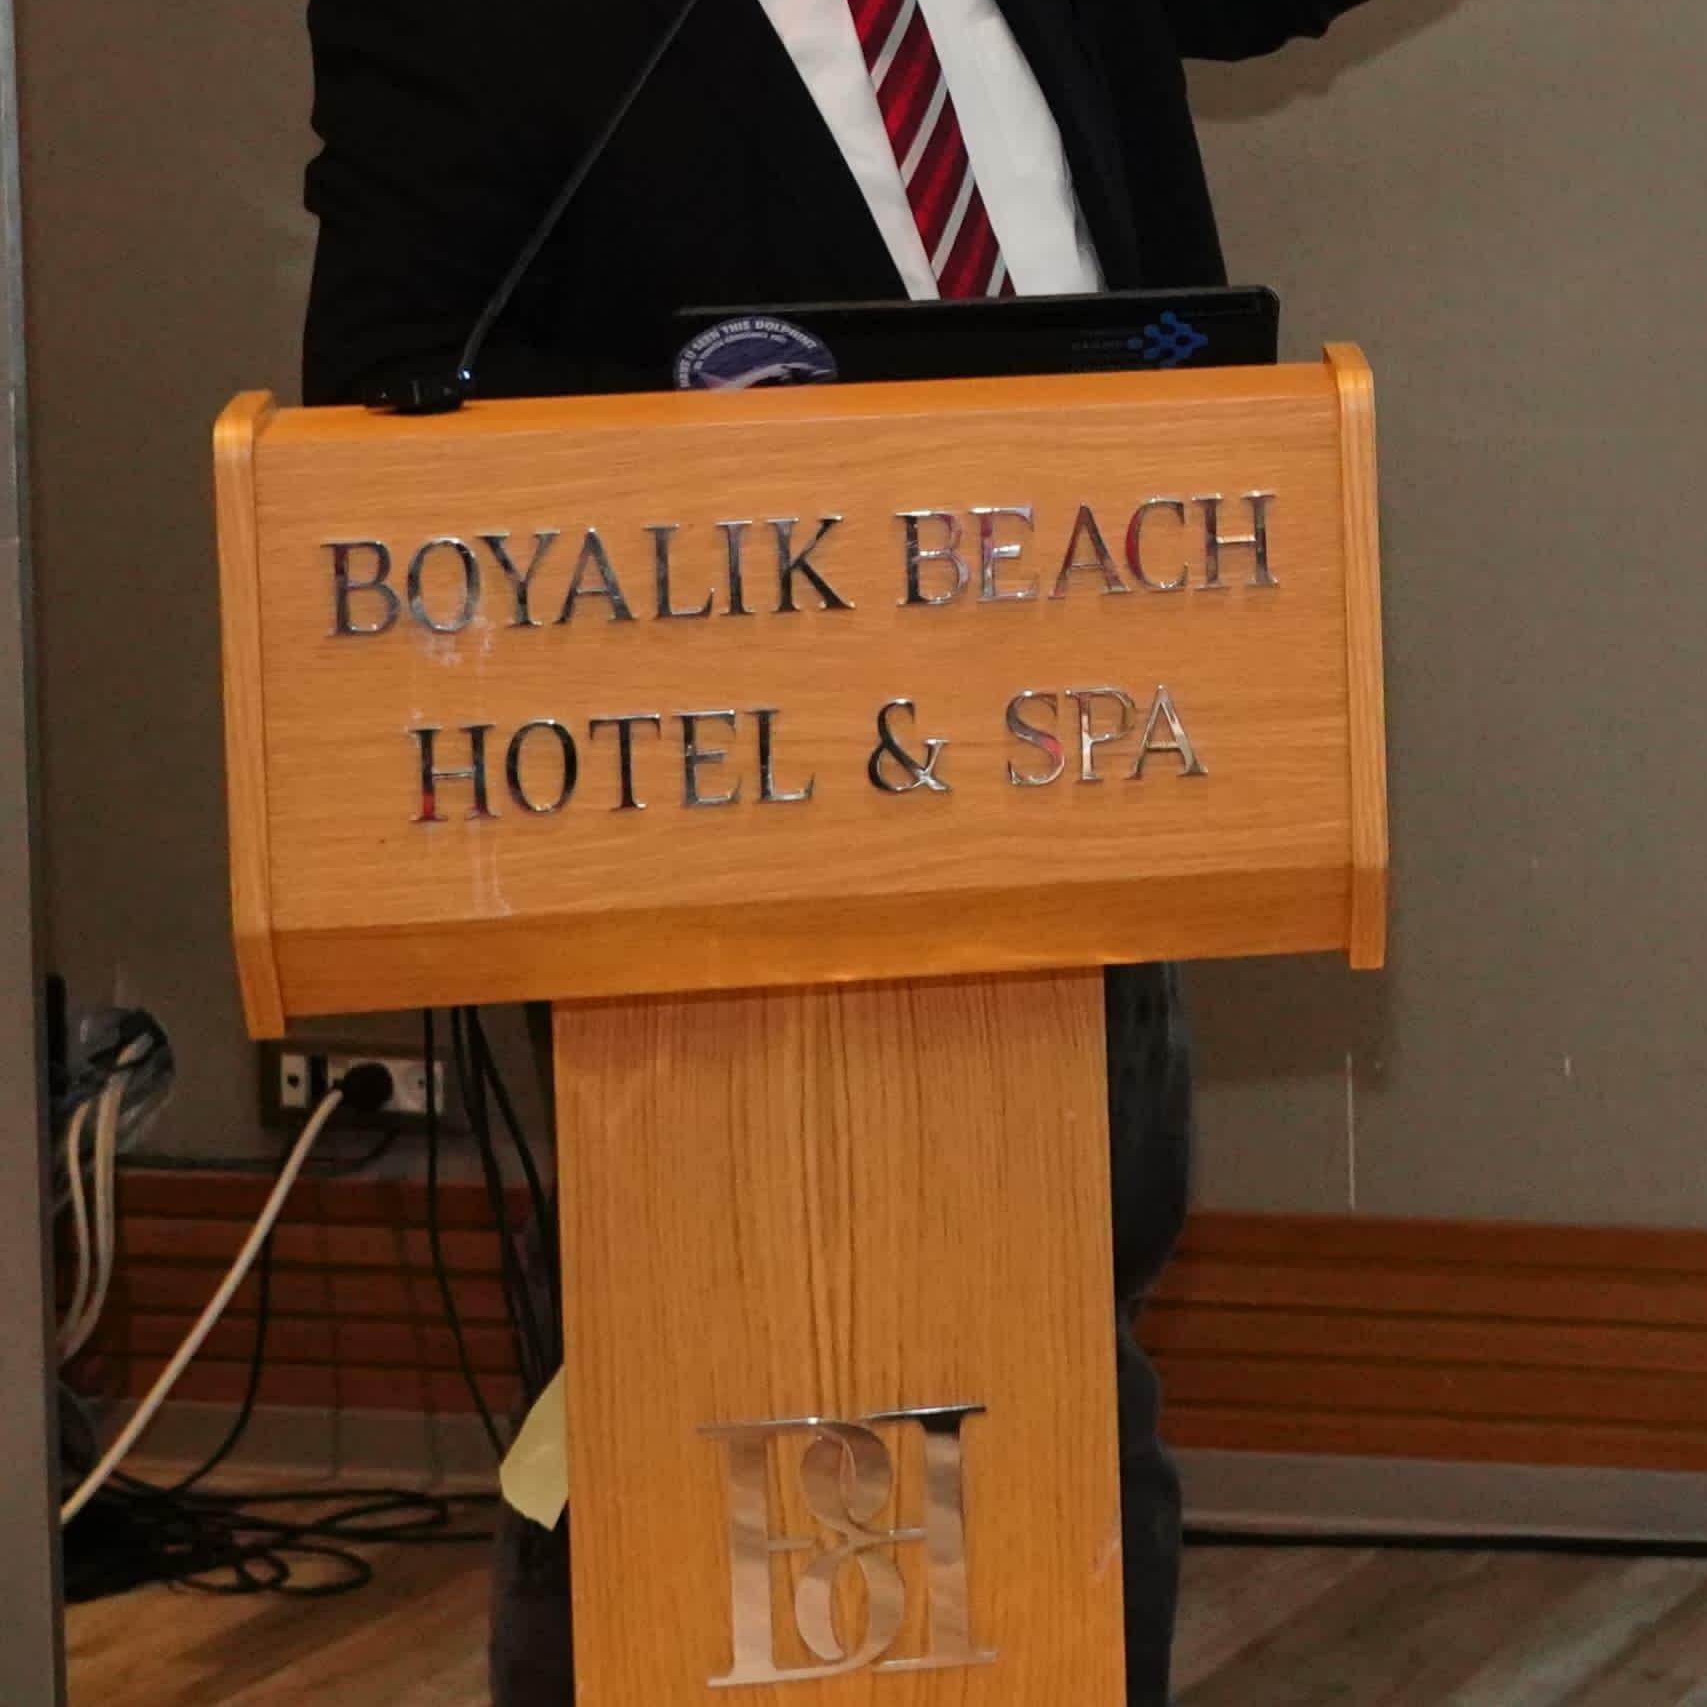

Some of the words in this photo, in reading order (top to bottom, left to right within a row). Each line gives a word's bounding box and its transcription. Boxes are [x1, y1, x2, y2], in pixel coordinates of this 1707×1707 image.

[321, 514, 857, 638] BOYALIK
[895, 488, 1279, 608] BEACH
[409, 707, 816, 823] HOTEL
[866, 701, 951, 795] &
[1004, 684, 1210, 788] SPA
